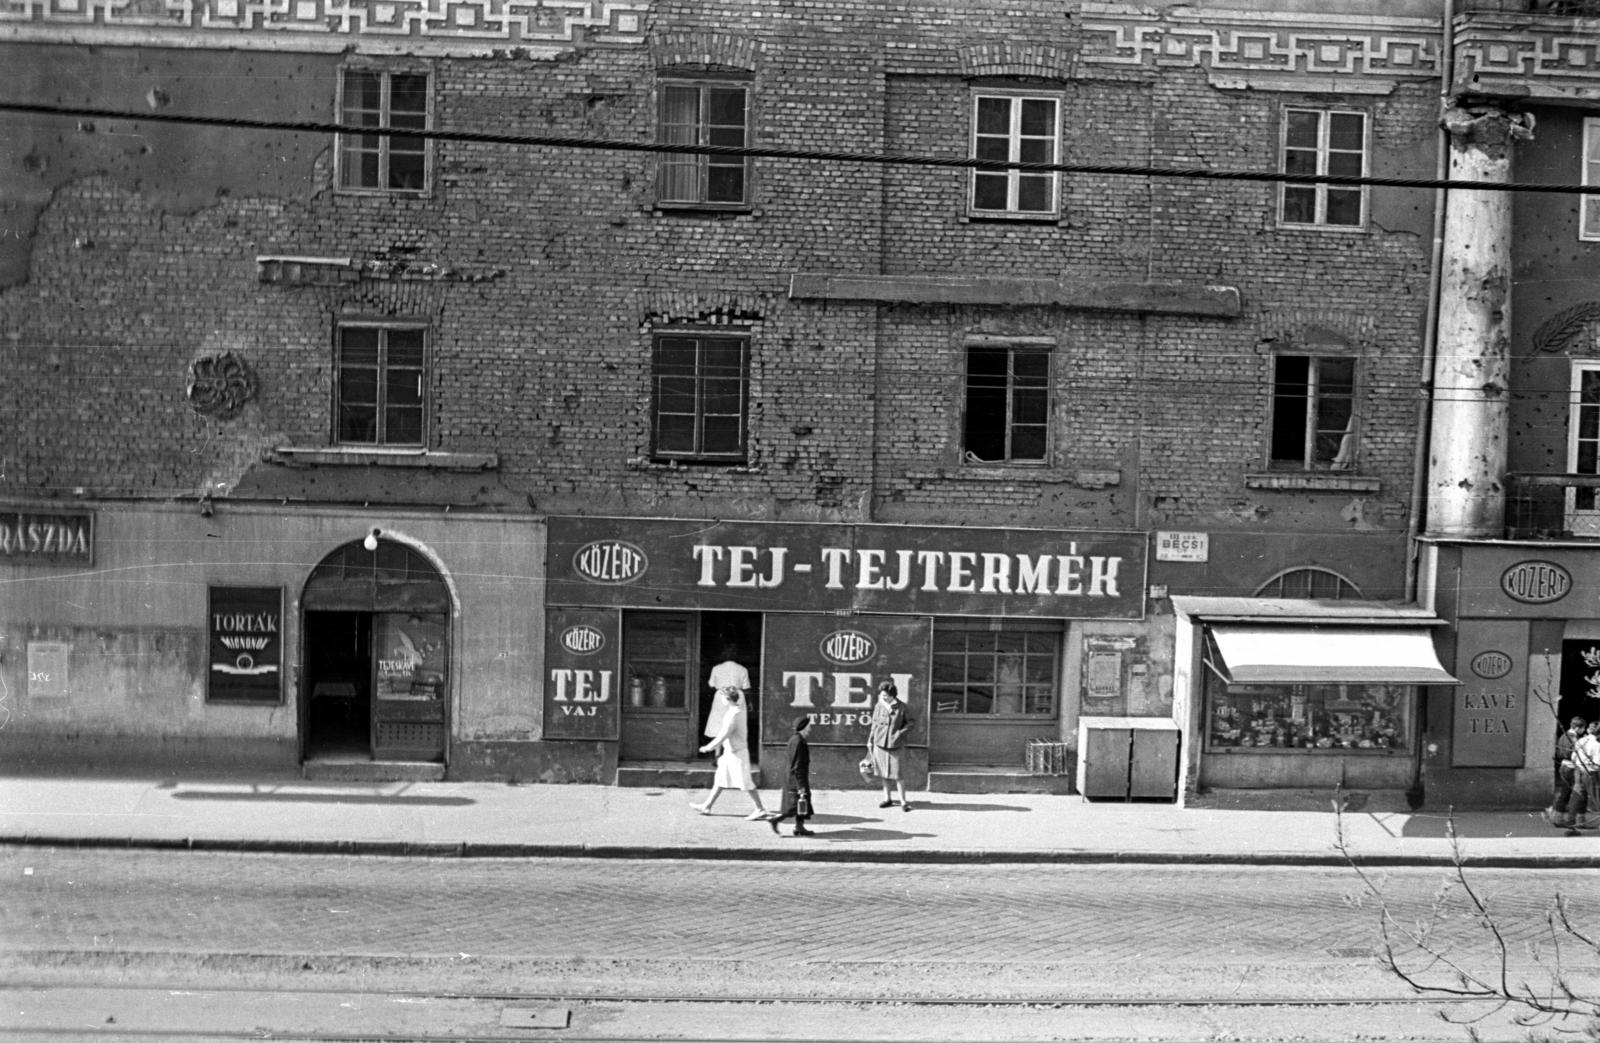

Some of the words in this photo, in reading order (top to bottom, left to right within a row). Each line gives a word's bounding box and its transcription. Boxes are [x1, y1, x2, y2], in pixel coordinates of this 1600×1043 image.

[580, 542, 641, 580] KÖZÉRT
[213, 610, 278, 632] TORTÁK
[566, 627, 601, 651] KÖZÉRT
[826, 632, 872, 661] KÖZÉRT
[551, 668, 613, 702] TEJ
[560, 705, 598, 717] VAJ
[1470, 718, 1510, 734] TEA
